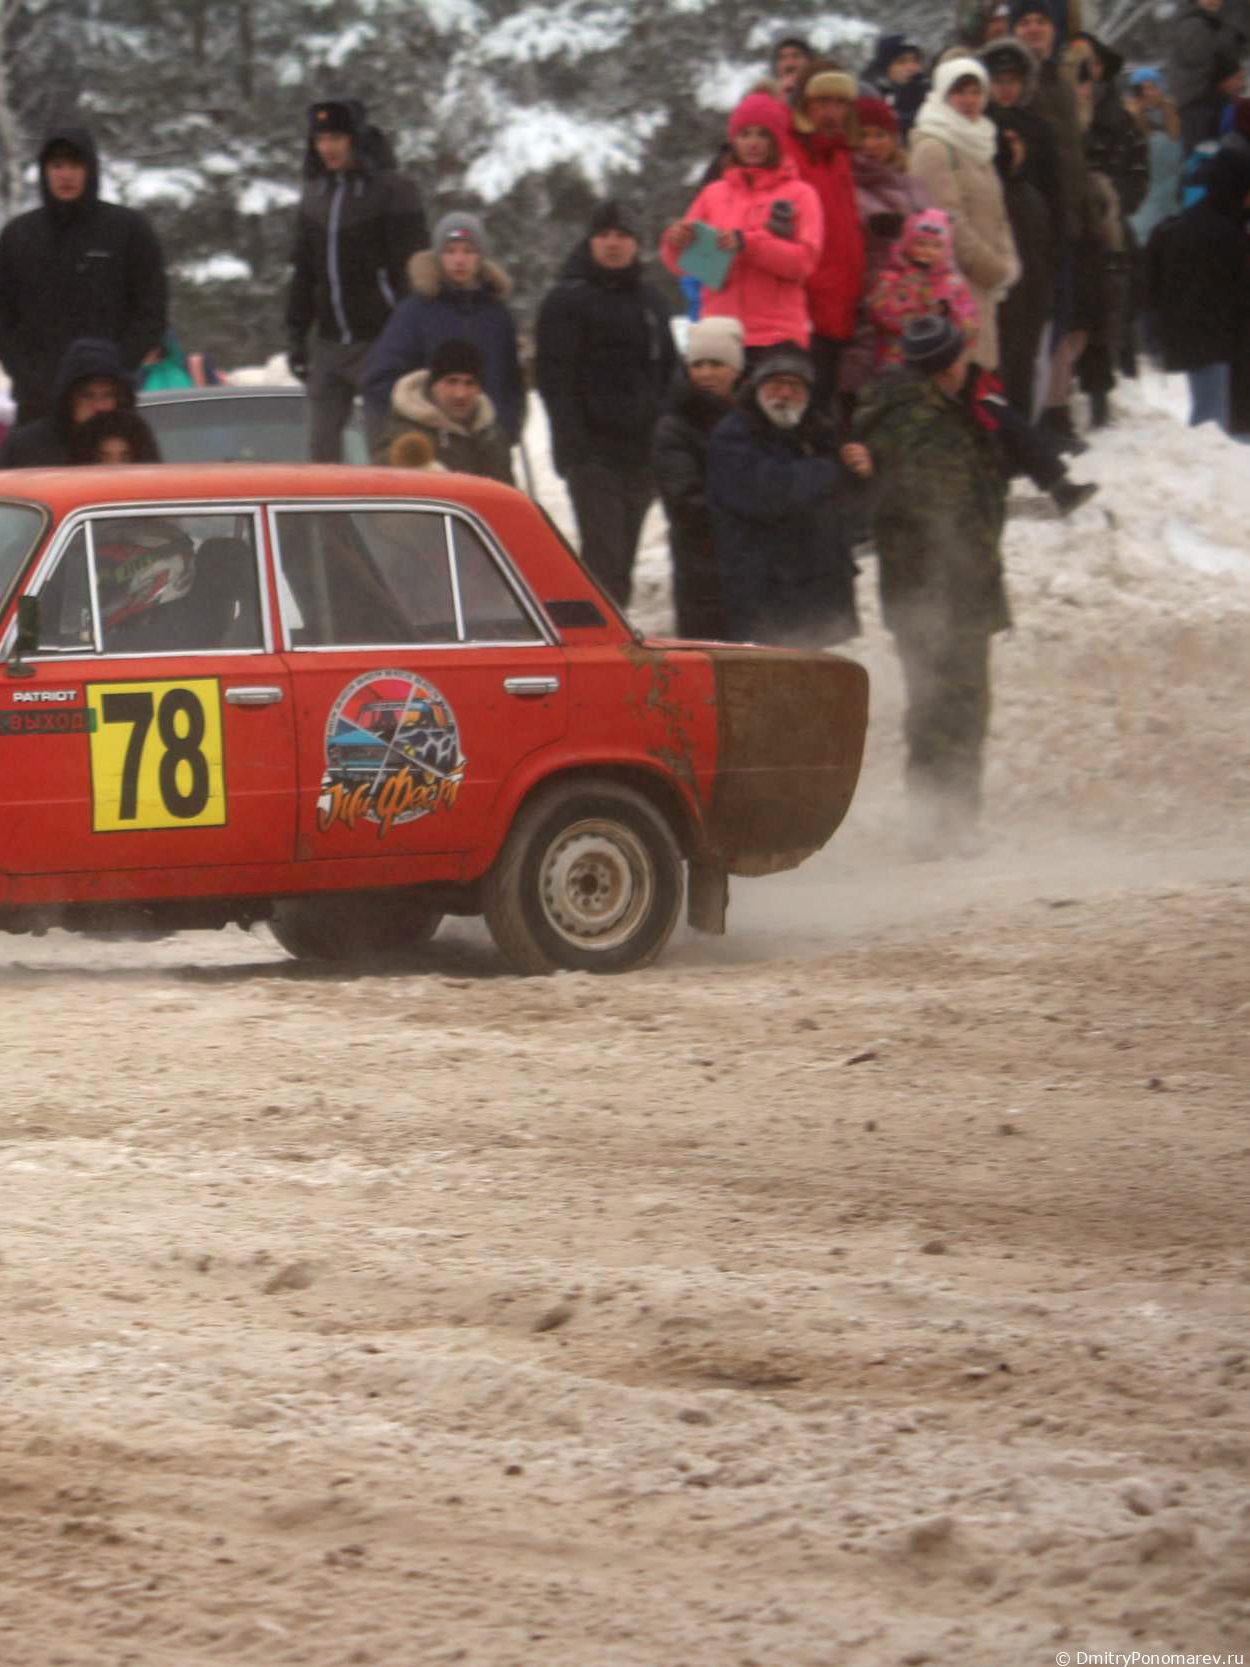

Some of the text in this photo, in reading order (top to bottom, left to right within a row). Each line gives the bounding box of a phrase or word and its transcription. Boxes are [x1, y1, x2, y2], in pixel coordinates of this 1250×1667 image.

[13, 690, 78, 702] PATRIOT
[11, 713, 85, 730] ВЫХОД
[101, 688, 210, 820] 78
